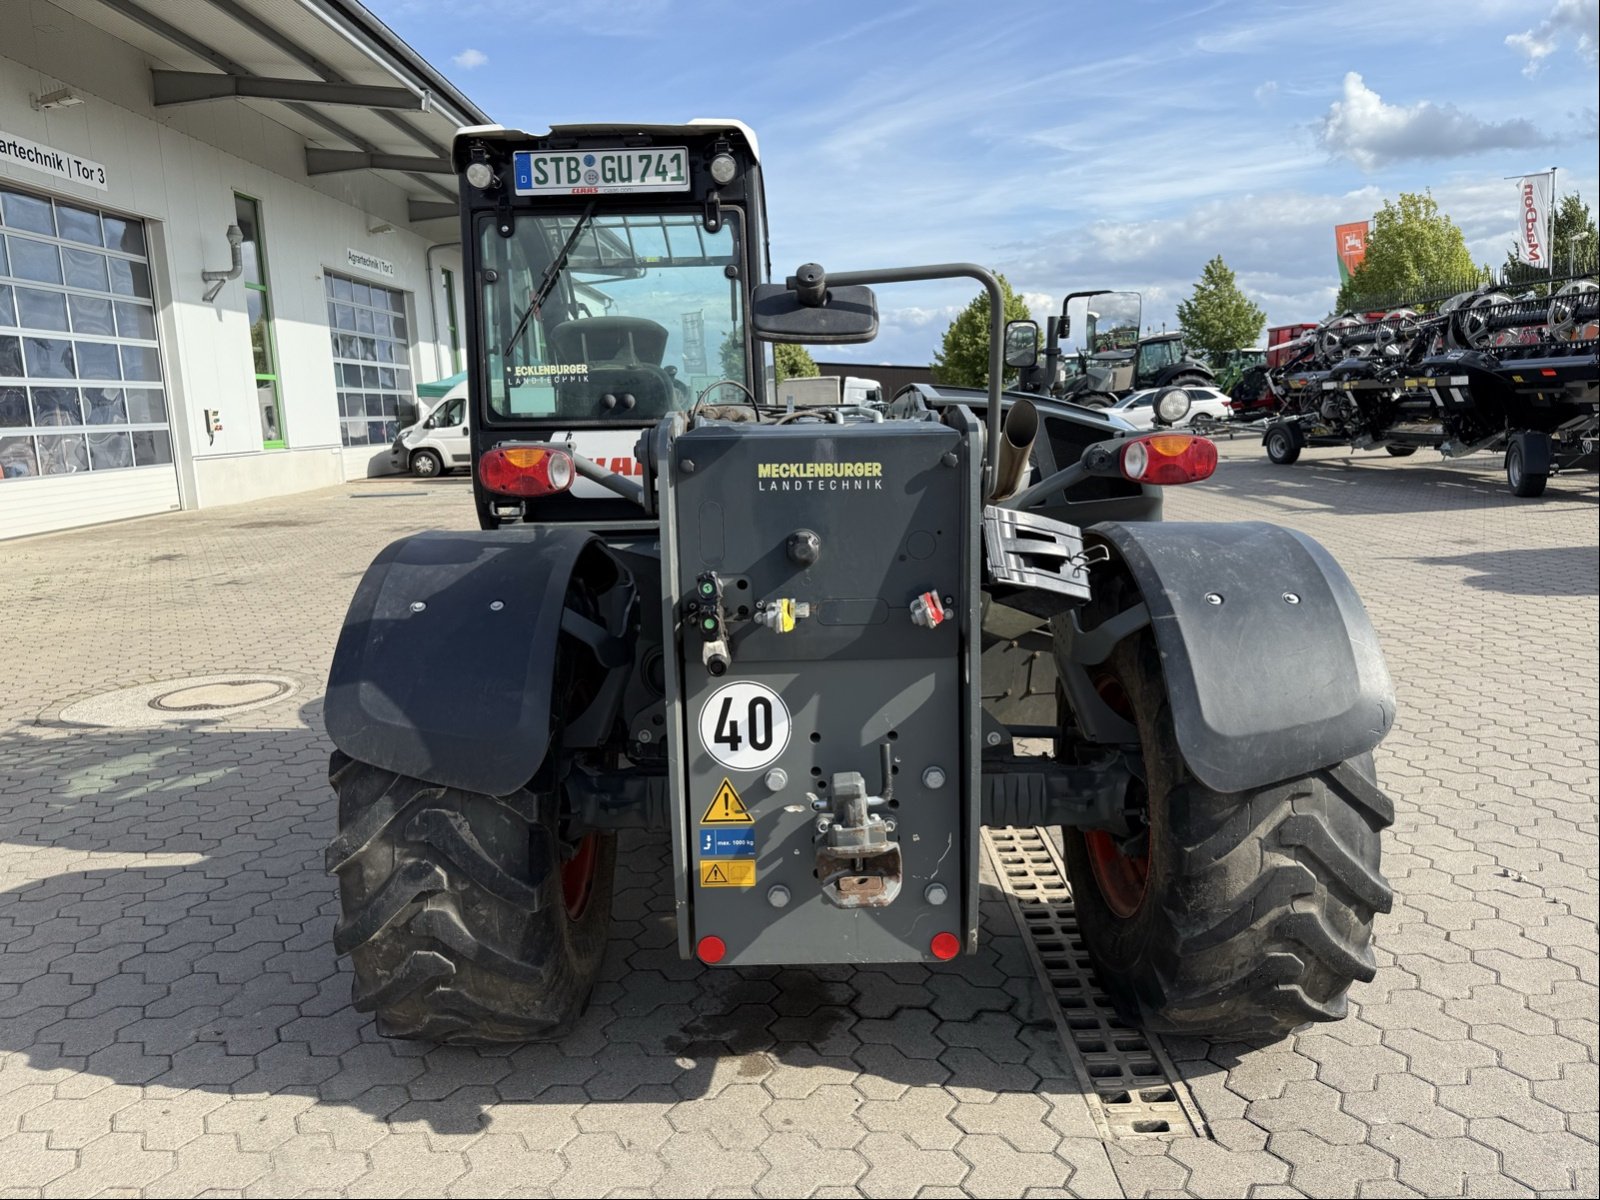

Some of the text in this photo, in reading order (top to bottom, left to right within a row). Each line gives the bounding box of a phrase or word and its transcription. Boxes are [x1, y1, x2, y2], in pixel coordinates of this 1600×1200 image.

[74, 160, 94, 180] Tor
[98, 168, 105, 184] 3
[534, 153, 685, 185] STB GU 741
[521, 175, 528, 184] D
[348, 250, 379, 270] Agrartechnik
[506, 364, 589, 377] ECKLENBURGER
[758, 462, 883, 478] MECKLENBURGER
[758, 480, 883, 492] LANDTECHNIK
[714, 696, 773, 752] 40
